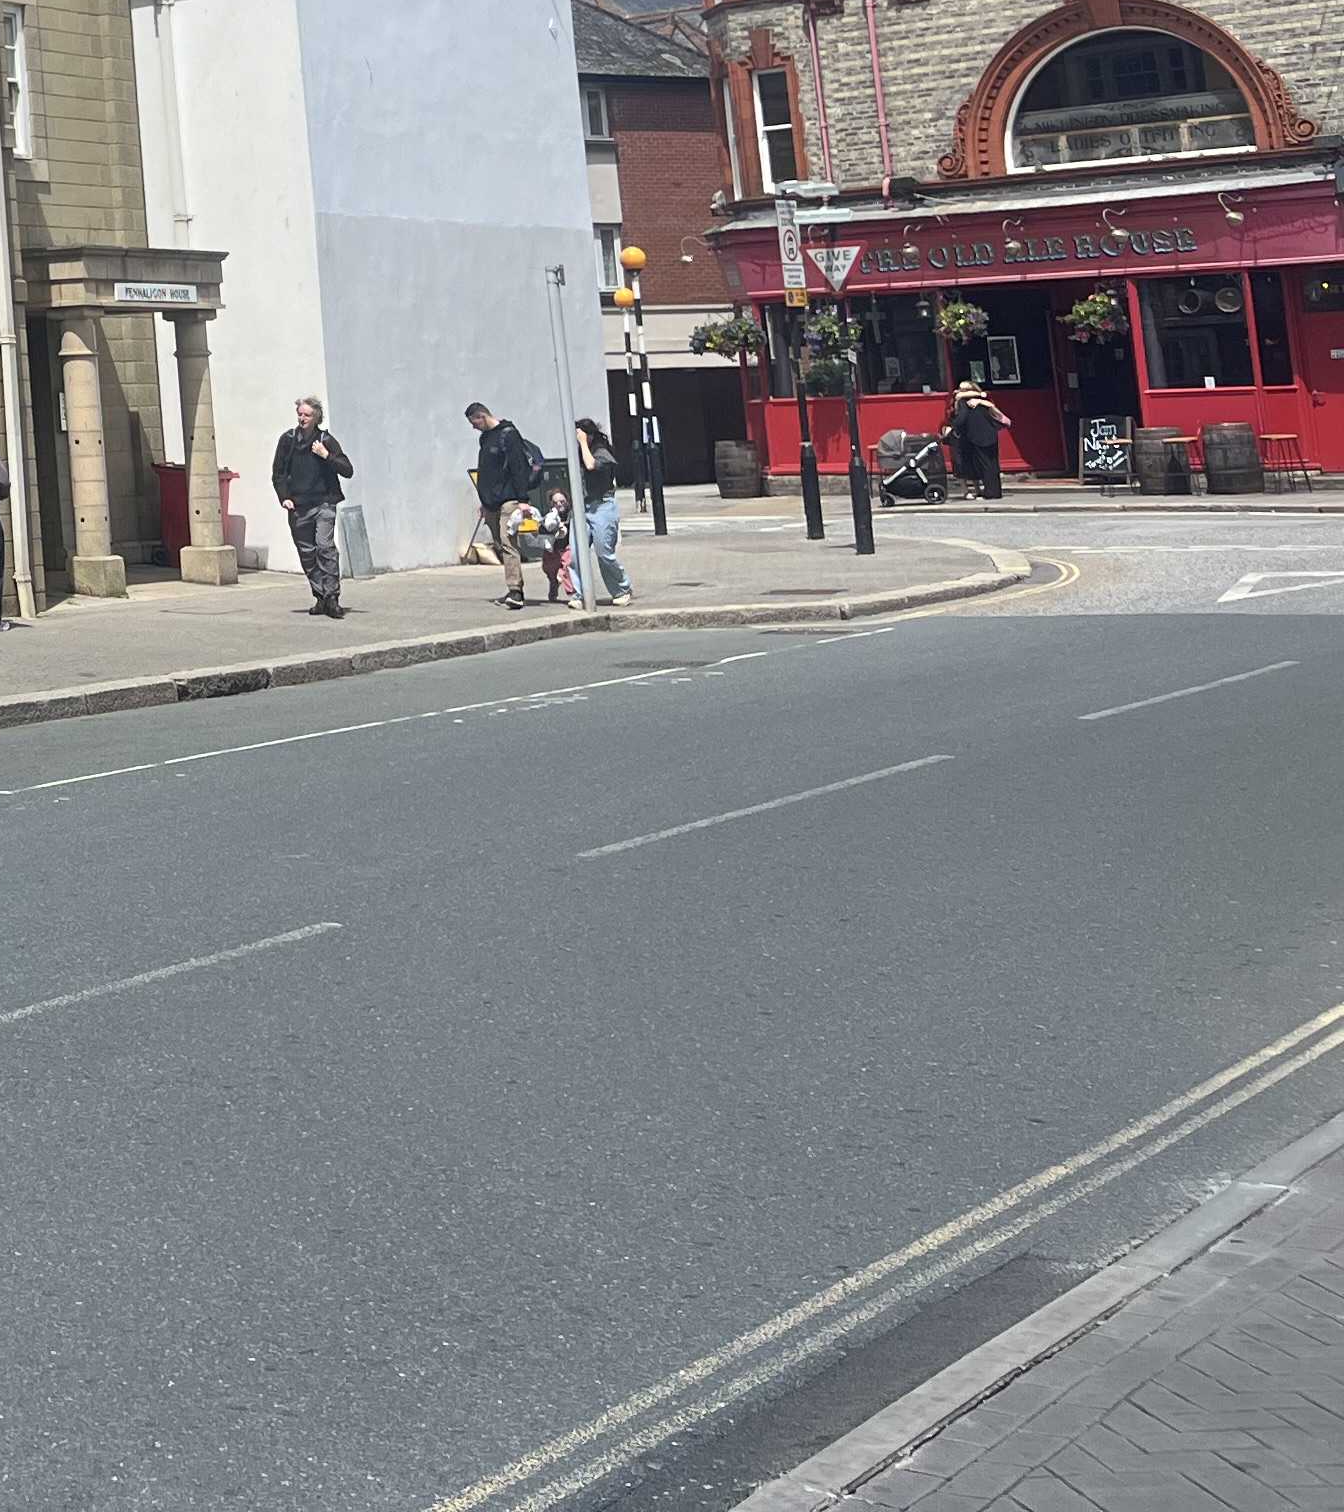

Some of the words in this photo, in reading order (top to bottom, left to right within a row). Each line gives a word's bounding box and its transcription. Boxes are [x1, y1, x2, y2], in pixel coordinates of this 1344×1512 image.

[814, 249, 852, 262] GIVE
[928, 242, 995, 270] OLD
[1004, 237, 1067, 264] ALE
[1073, 228, 1198, 259] HOUSE
[824, 263, 846, 273] WAY
